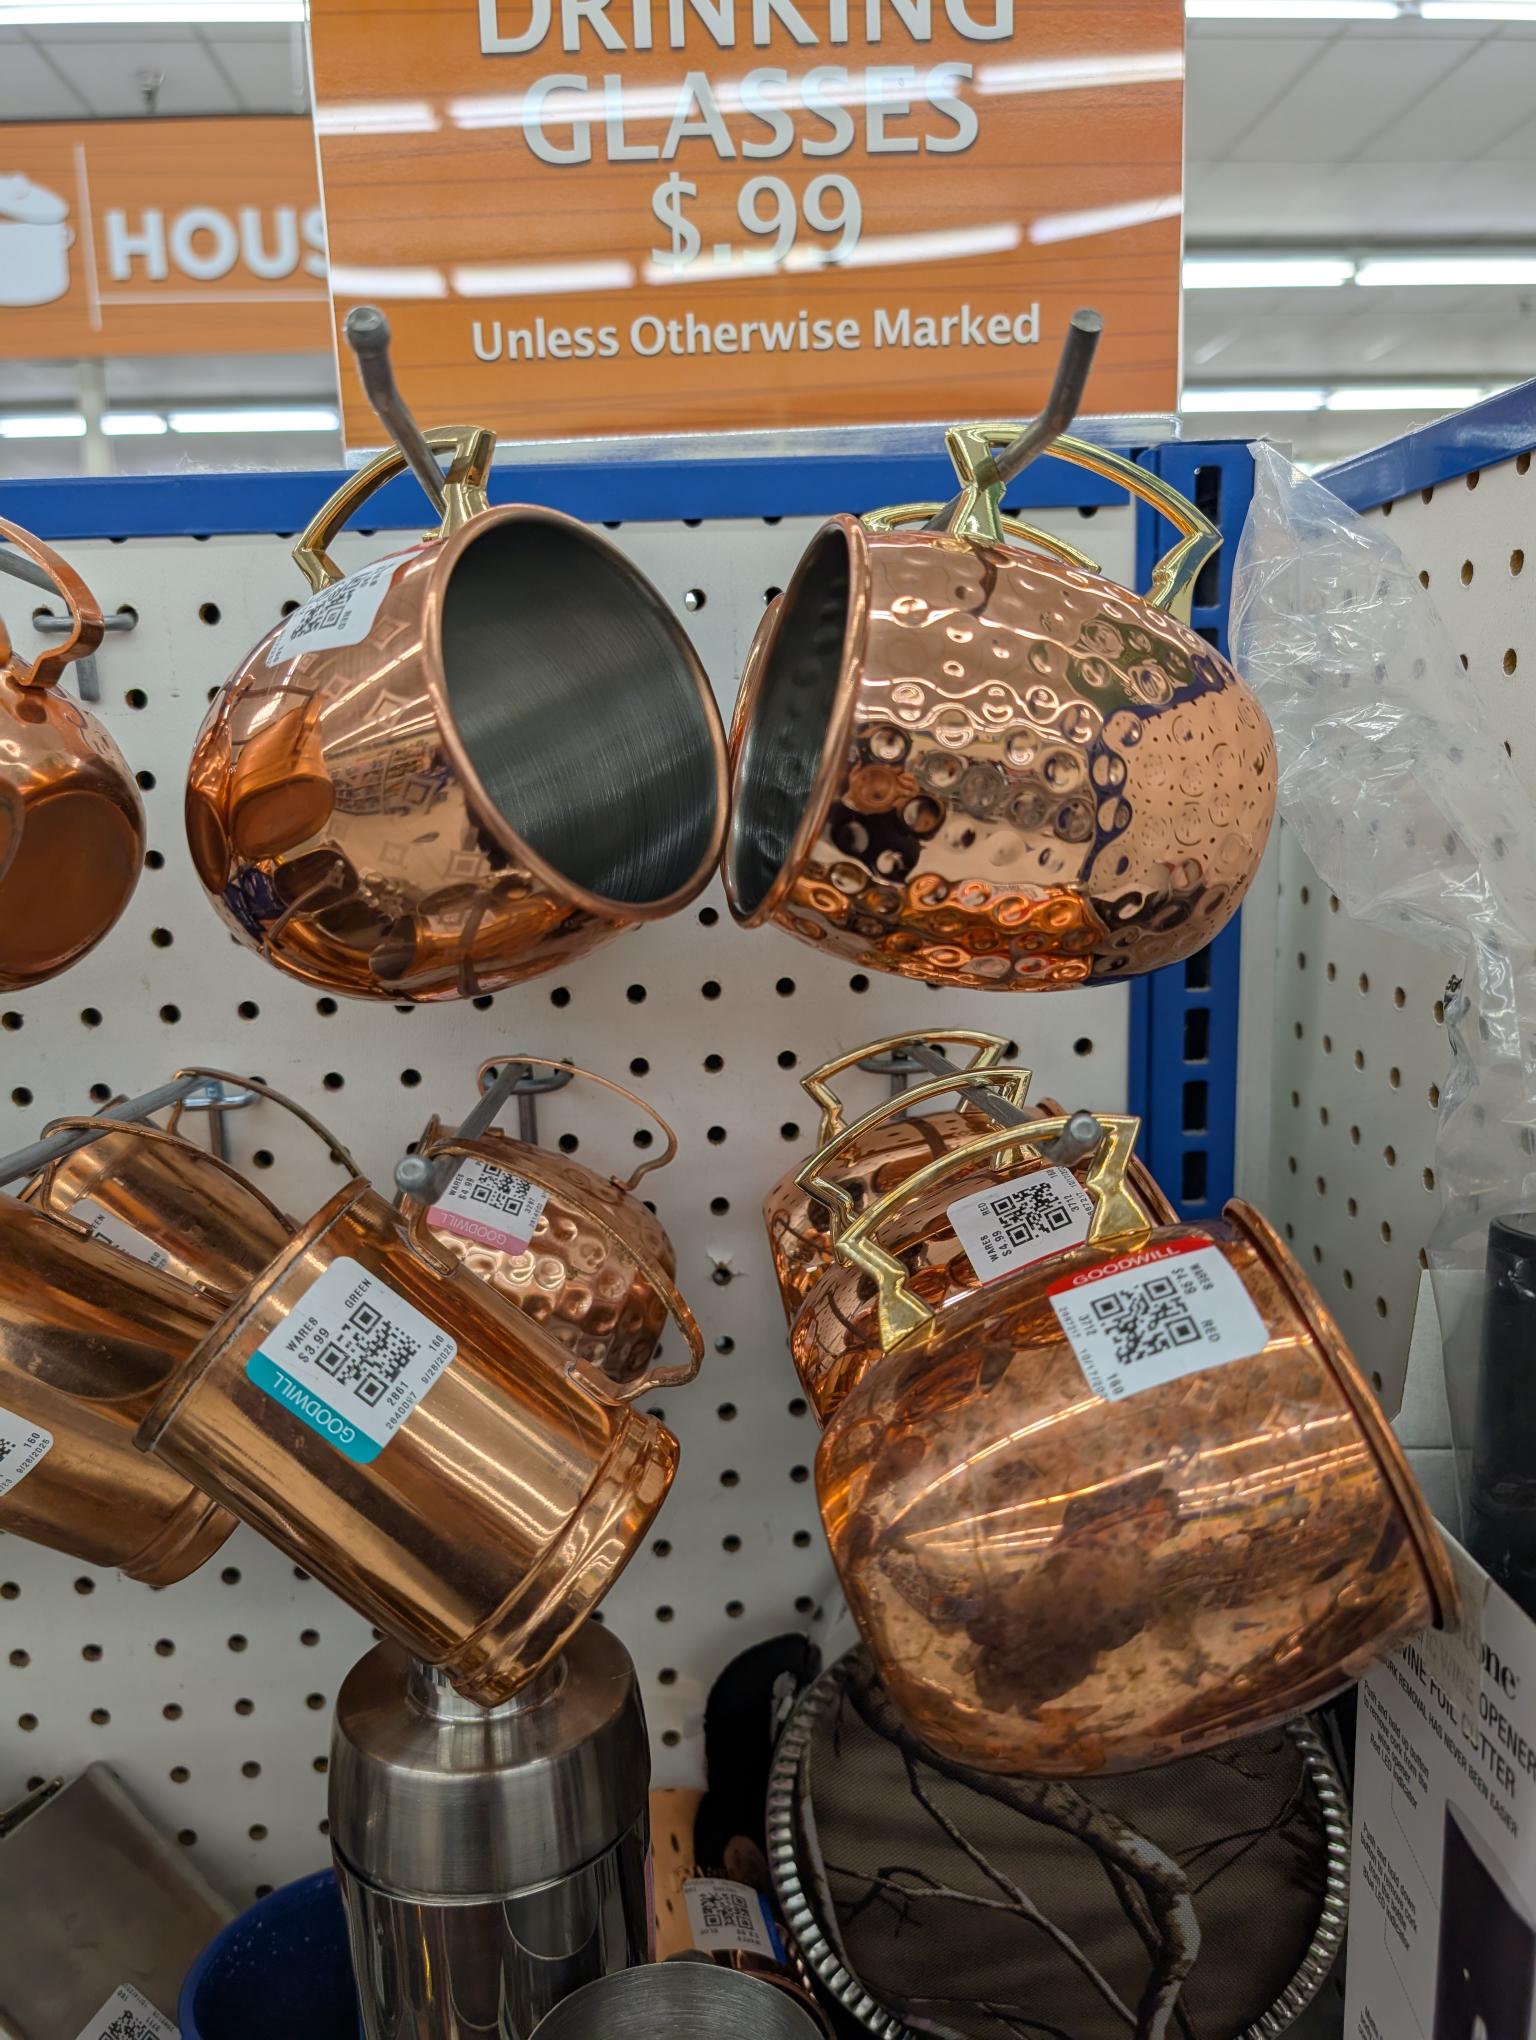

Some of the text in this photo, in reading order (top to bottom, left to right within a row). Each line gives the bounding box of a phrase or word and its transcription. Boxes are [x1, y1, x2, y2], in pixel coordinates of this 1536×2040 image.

[522, 62, 980, 165] GLASSES
[651, 172, 863, 275] $.99
[472, 303, 1040, 362] Unless Otherwise Marked
[440, 1212, 507, 1245] GOODWILL
[978, 1202, 1012, 1257] $4.99 RED
[1064, 1193, 1079, 1213] 3712
[981, 1234, 999, 1262] WARES
[1072, 1246, 1181, 1287] GOODWILL
[1190, 1263, 1215, 1291] WARES
[286, 1316, 319, 1352] WARES
[298, 1279, 372, 1363] $3.99 GREEN
[1202, 1319, 1221, 1343] RED
[387, 1334, 445, 1406] 2861 160
[1078, 1314, 1124, 1395] 3712 160
[273, 1371, 356, 1443] GOODWILL
[23, 1432, 41, 1448] 160
[1378, 1700, 1388, 1720] and
[1388, 1714, 1401, 1738] hold
[1410, 1744, 1429, 1779] button
[1381, 1749, 1392, 1772] LED
[1399, 1674, 1428, 1721] REMOVAL
[1428, 1711, 1443, 1740] HAS
[1444, 1735, 1467, 1772] NEVER
[1468, 1764, 1489, 1800] BEEN
[1490, 1793, 1518, 1839] EASIER
[1460, 1710, 1515, 1799] CUTTER
[1479, 1691, 1536, 1785] OPENER
